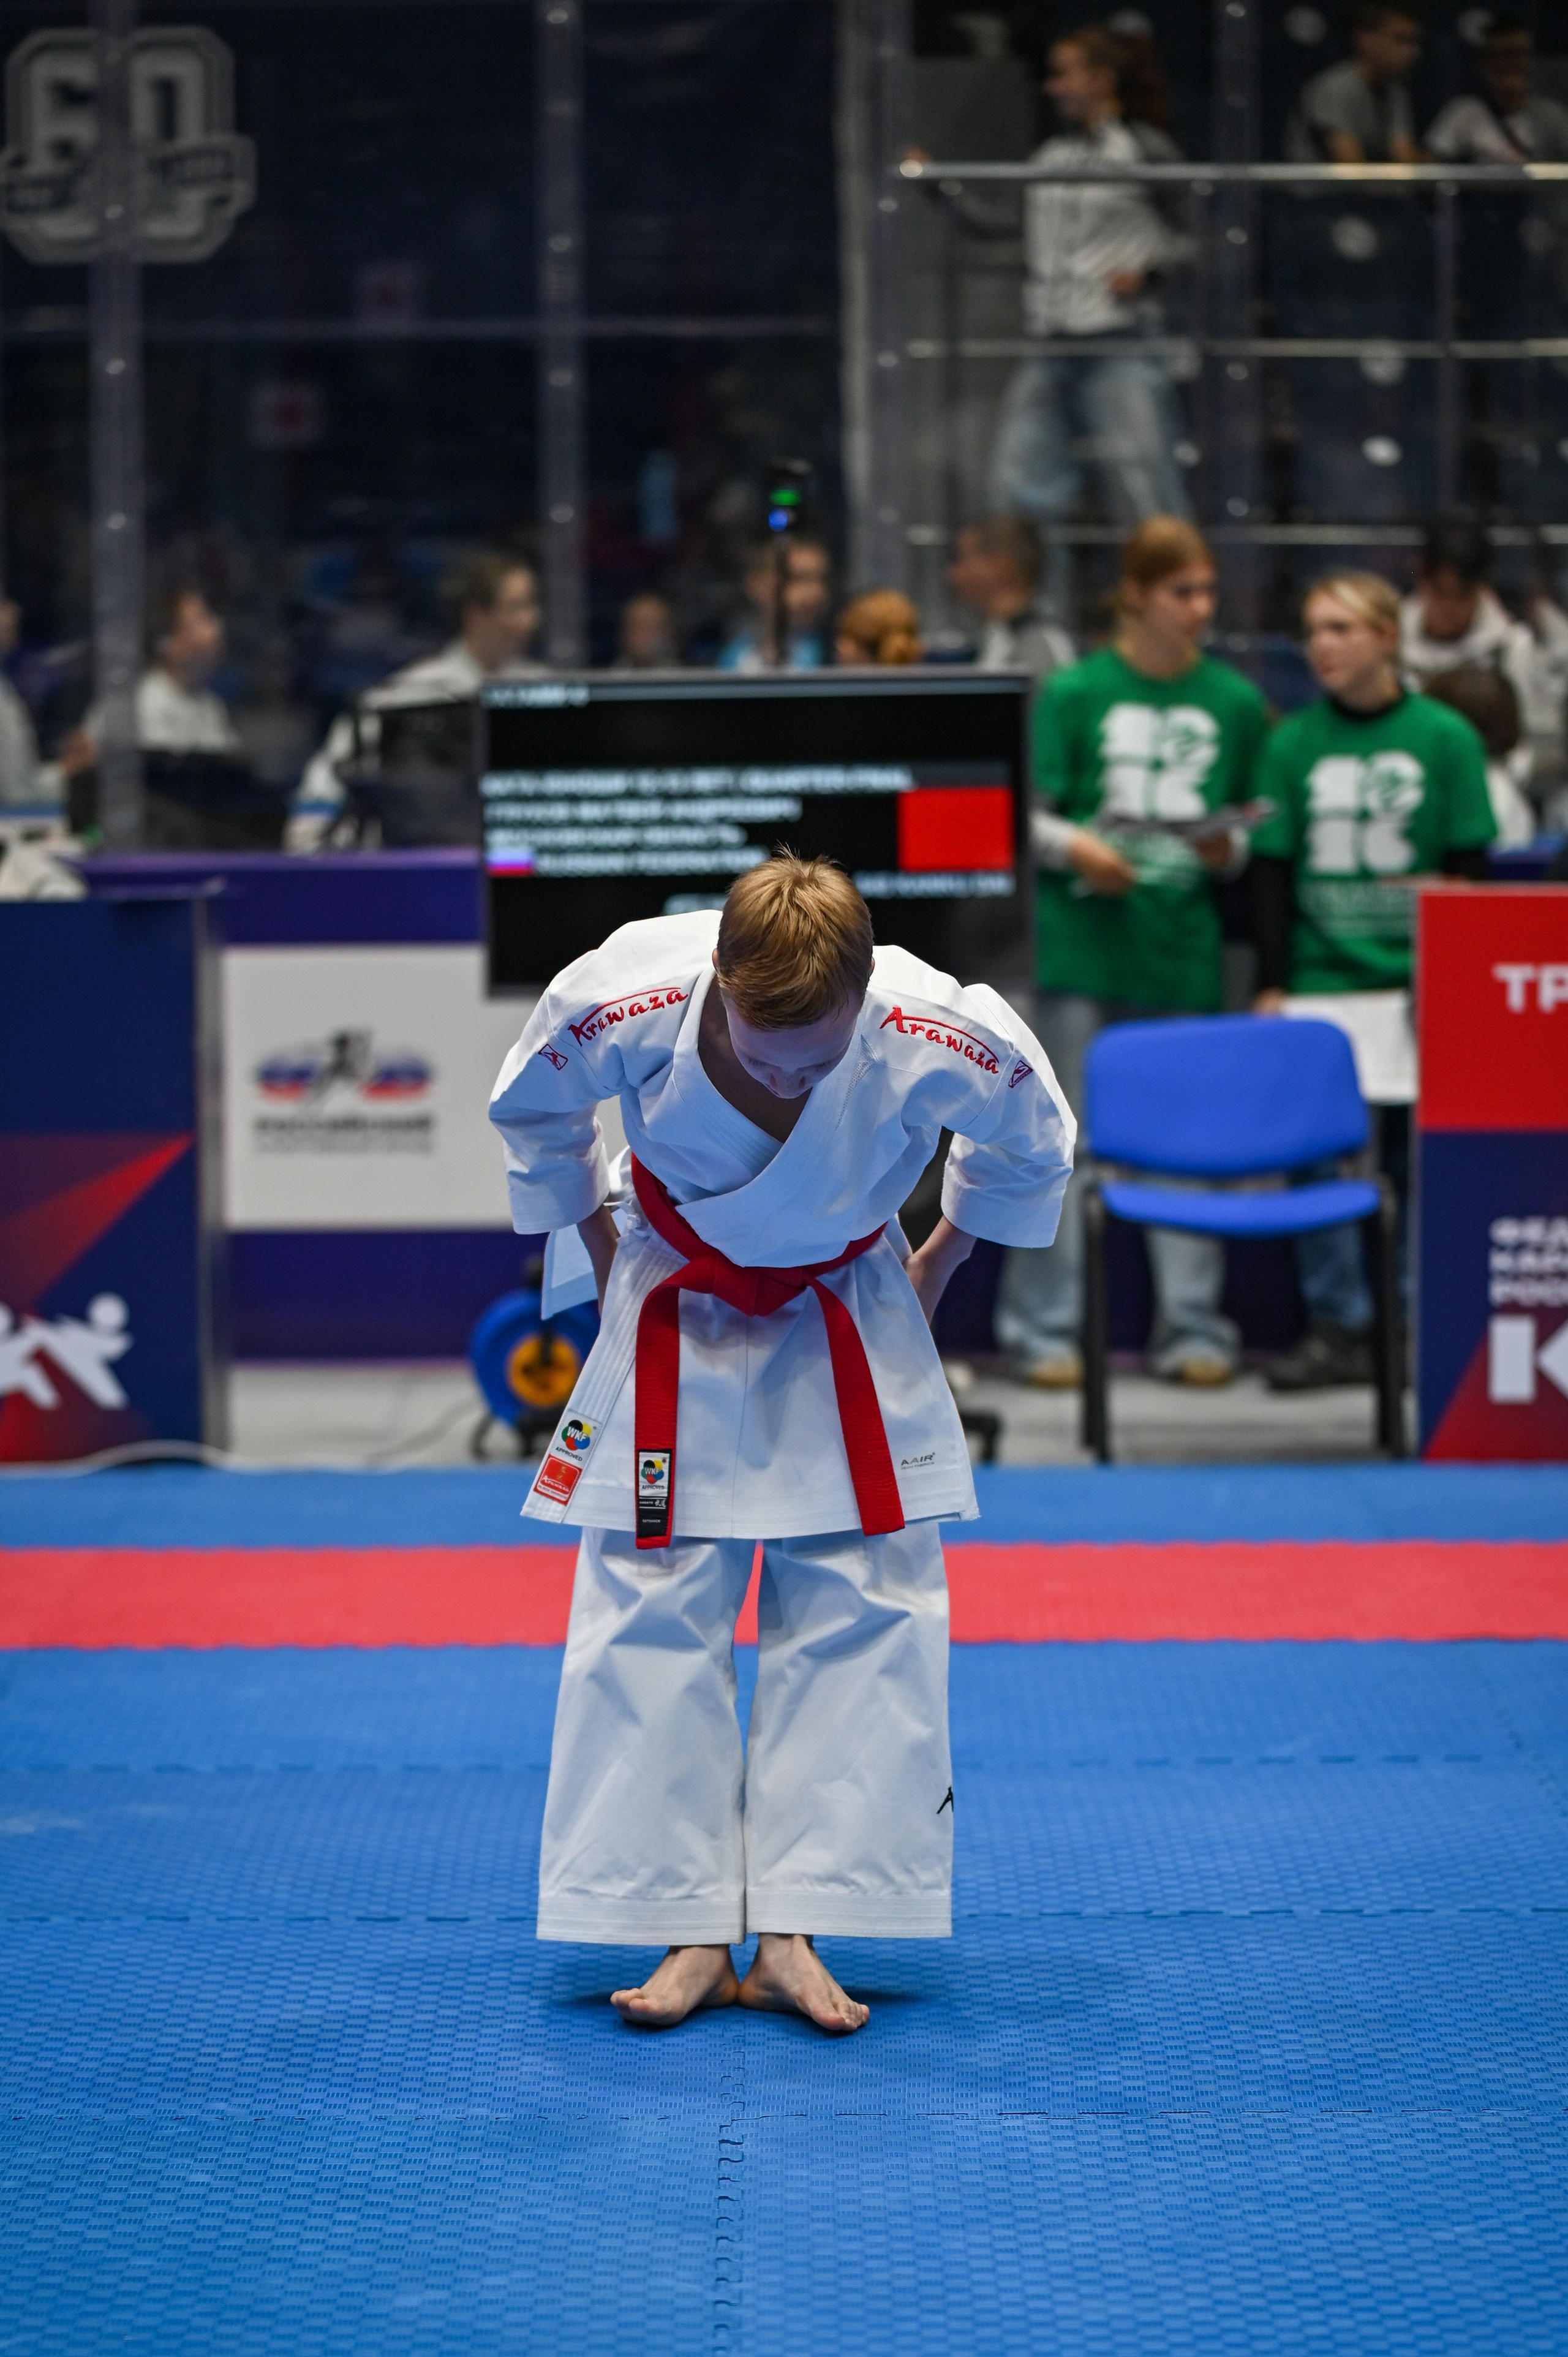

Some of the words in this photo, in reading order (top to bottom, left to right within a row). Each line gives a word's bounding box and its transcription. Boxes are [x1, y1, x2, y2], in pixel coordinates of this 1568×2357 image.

[568, 987, 688, 1047] Arawaza
[880, 1005, 1000, 1074] Arawaza
[567, 1426, 587, 1441] WKF
[556, 1446, 583, 1461] APPROVED
